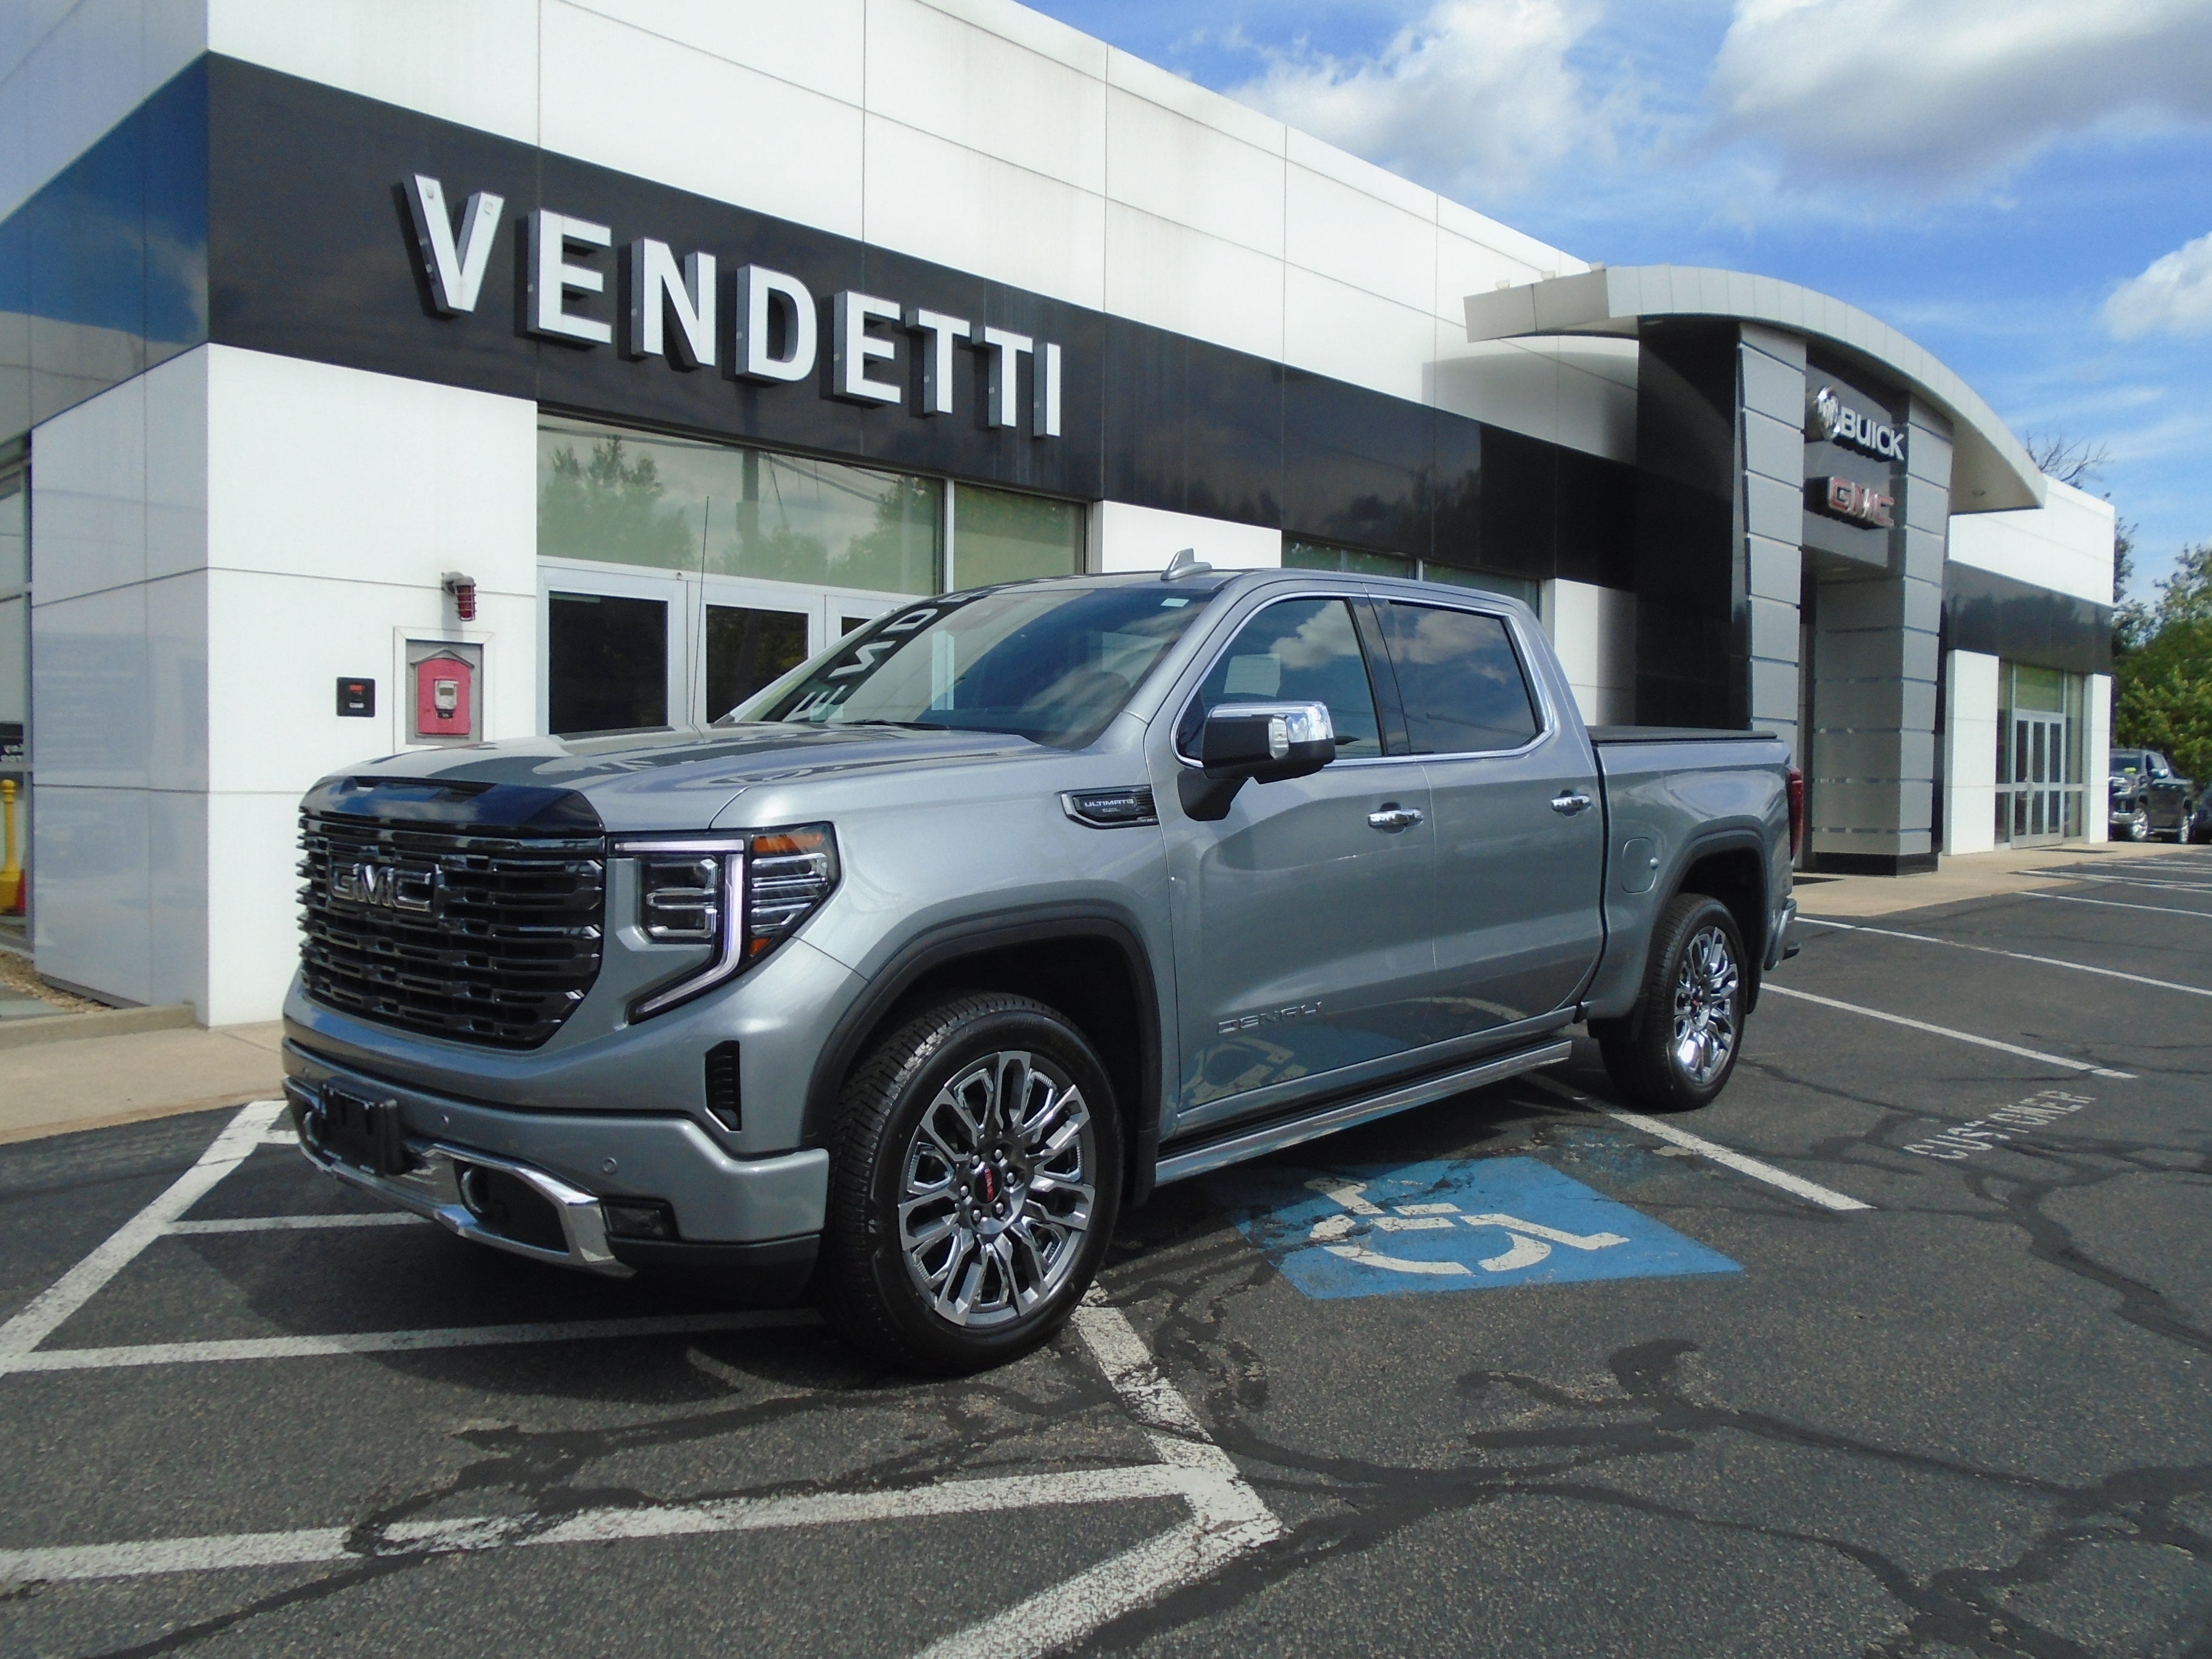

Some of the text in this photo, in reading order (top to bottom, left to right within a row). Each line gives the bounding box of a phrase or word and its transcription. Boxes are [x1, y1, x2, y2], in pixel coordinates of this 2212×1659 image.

[405, 173, 1061, 438] VENDETTI
[1838, 406, 1905, 461] BUICK
[1828, 476, 1895, 528] GMC
[329, 861, 434, 912] GMC
[1217, 1001, 1322, 1034] DENALI
[1902, 1090, 2096, 1160] CUSTOMER
